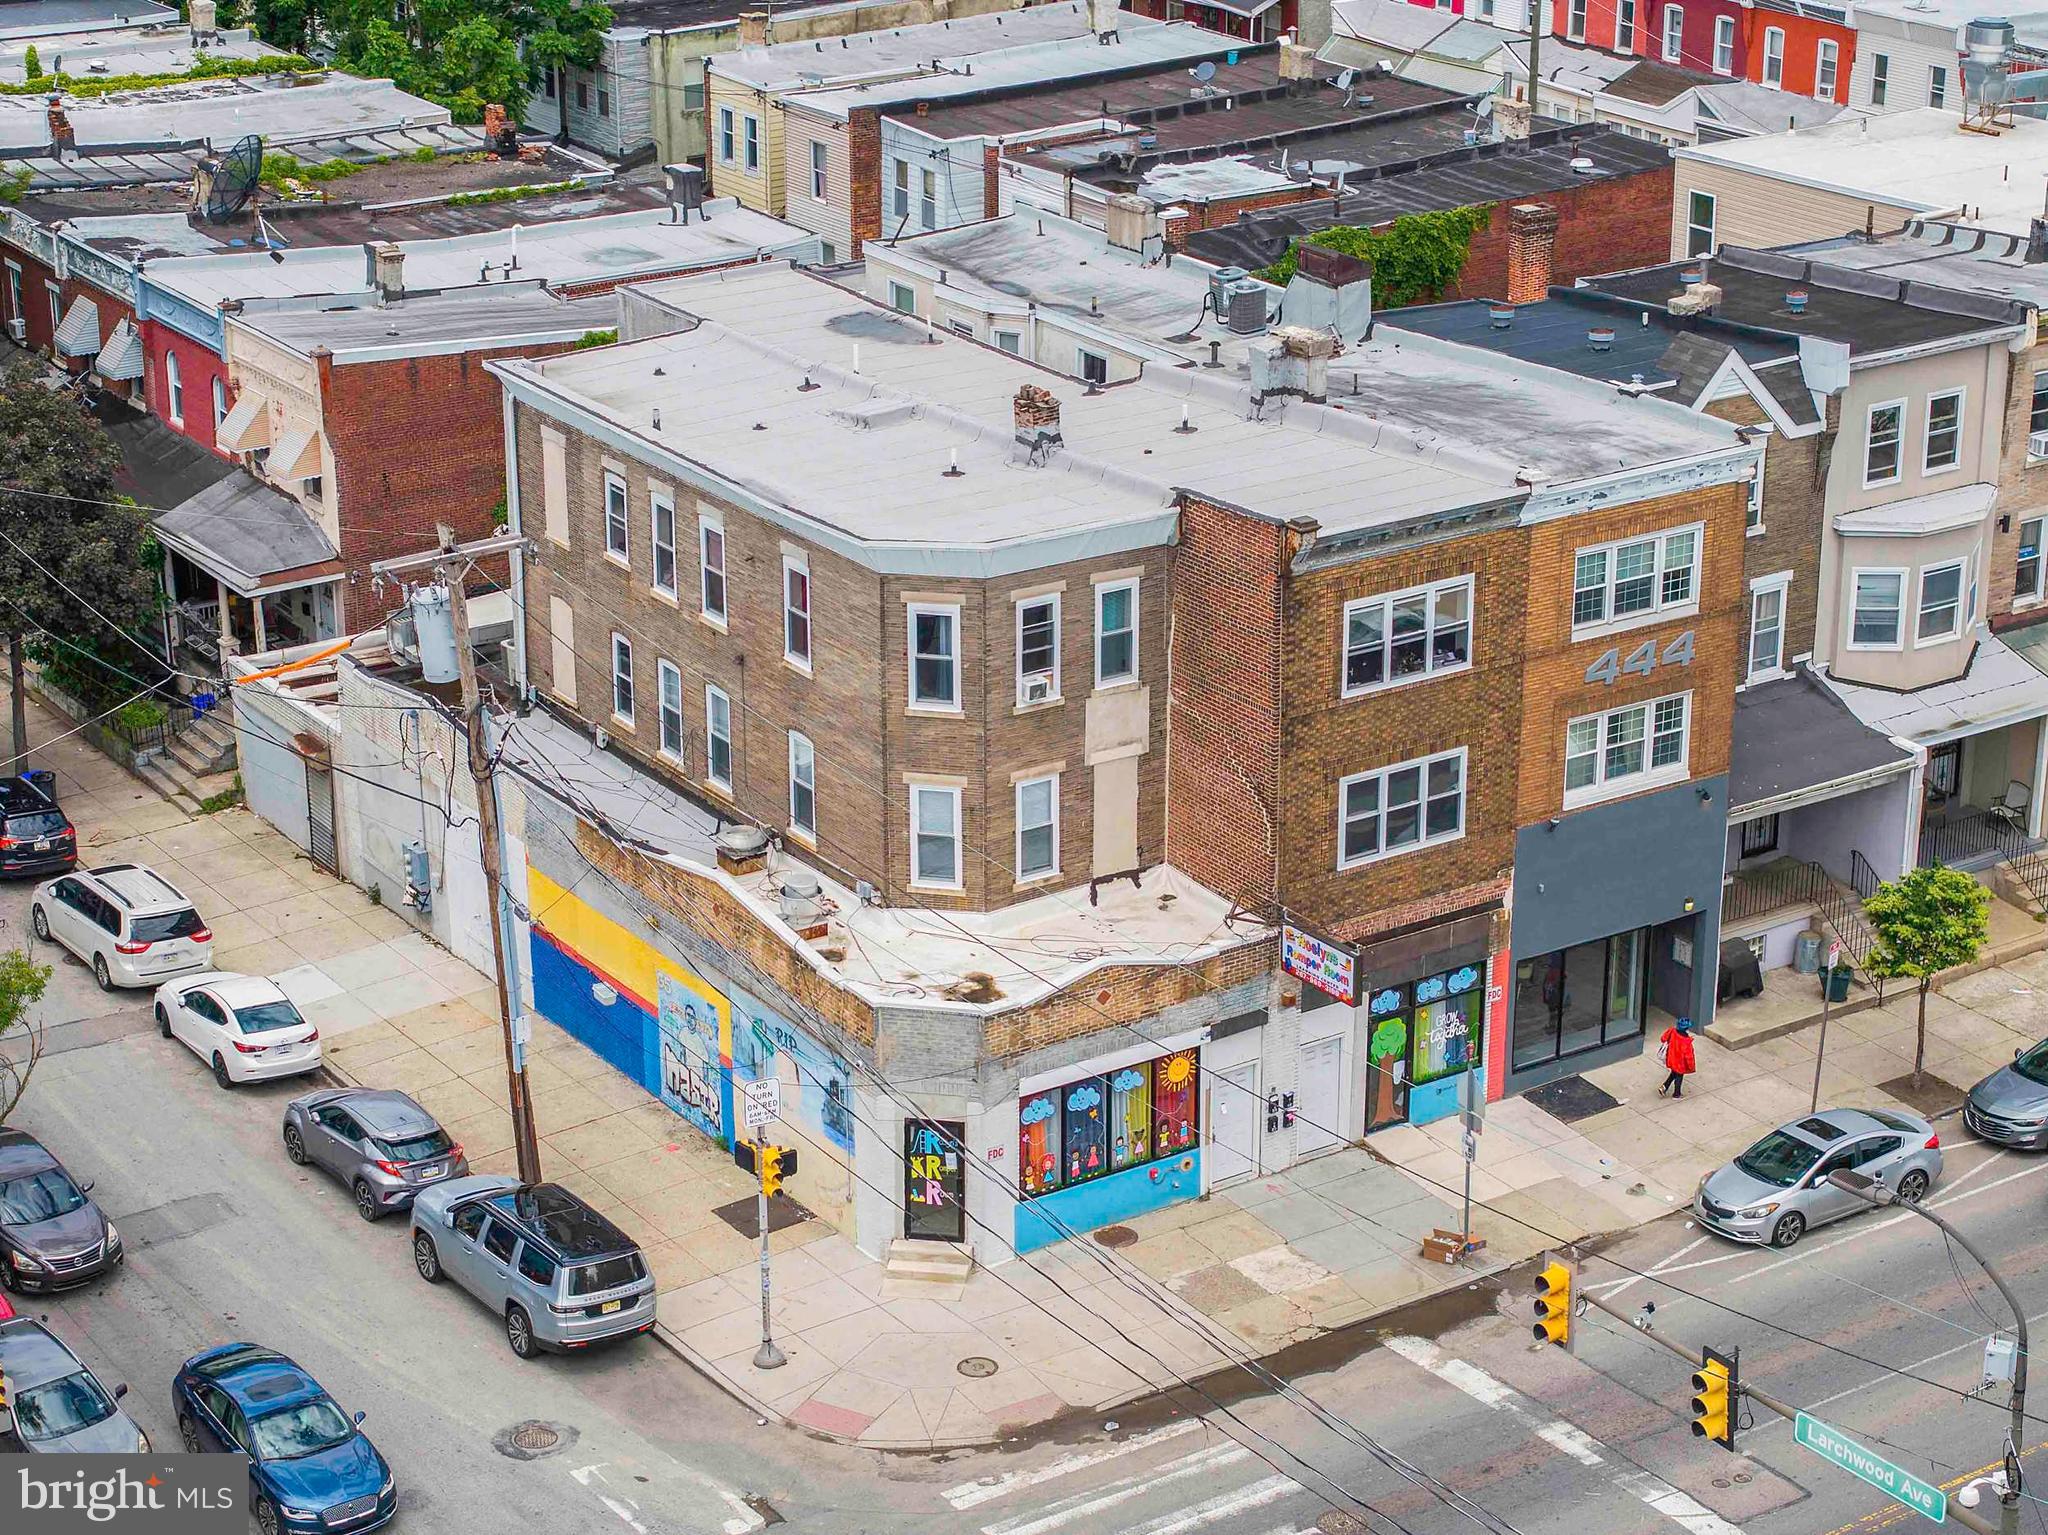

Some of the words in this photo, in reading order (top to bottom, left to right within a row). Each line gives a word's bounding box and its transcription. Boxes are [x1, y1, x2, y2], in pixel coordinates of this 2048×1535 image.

[1584, 630, 1696, 686] 444
[1287, 944, 1322, 971] Romper
[1324, 963, 1349, 987] Room
[1488, 988, 1502, 1000] FDC
[1436, 1010, 1459, 1027] GROW
[775, 1027, 798, 1052] RIP
[755, 1082, 769, 1090] NO
[752, 1090, 773, 1100] TURN
[762, 1099, 778, 1109] RED
[987, 1147, 1004, 1160] FDC
[1807, 1423, 1895, 1486] Larchwood
[1900, 1479, 1932, 1509] Ave
